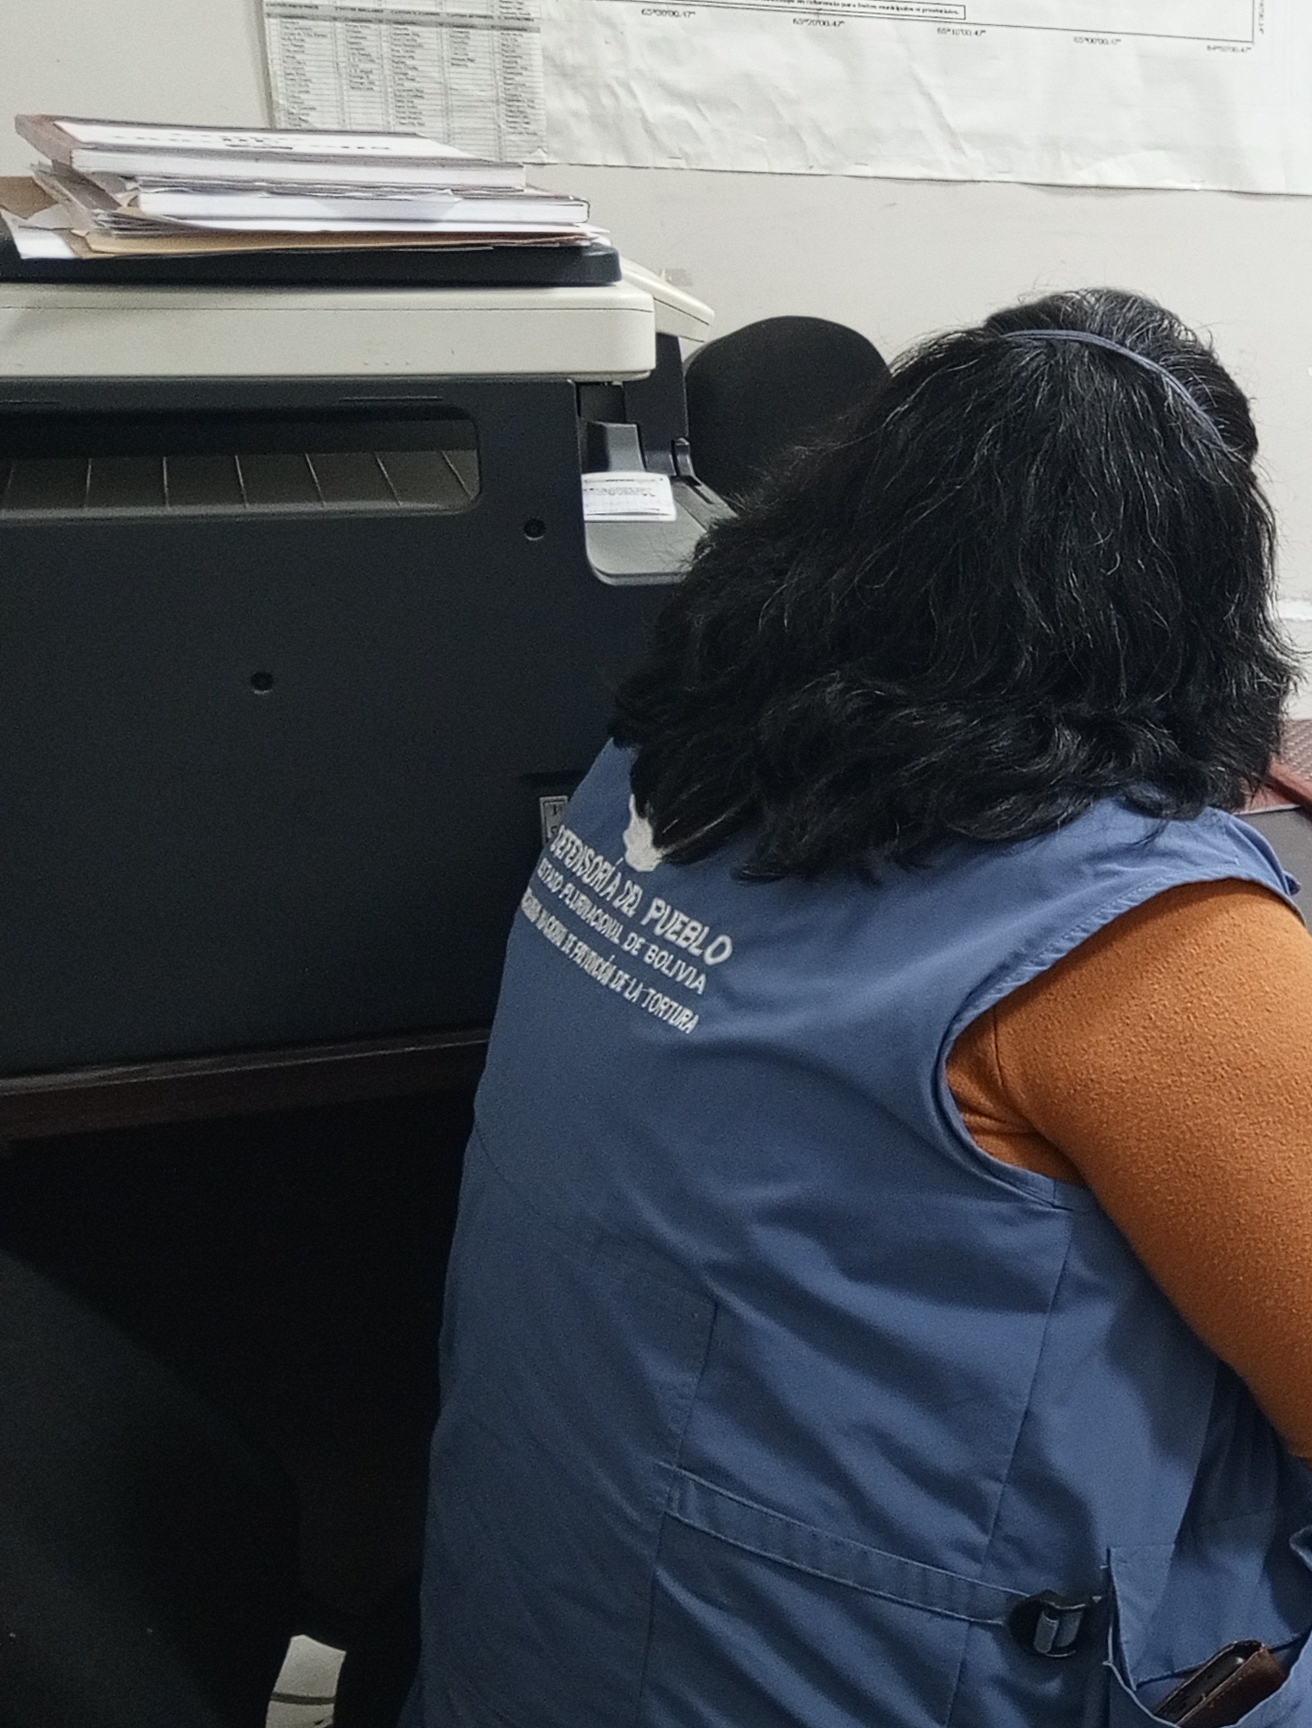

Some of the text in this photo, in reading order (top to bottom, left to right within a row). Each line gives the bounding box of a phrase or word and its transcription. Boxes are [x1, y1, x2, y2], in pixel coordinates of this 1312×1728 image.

[537, 857, 564, 894] ESTADO
[558, 882, 624, 946] PLURINACIONAL
[621, 931, 647, 957] DE
[643, 943, 707, 996] BOLIVIA
[612, 879, 644, 919] DEL
[640, 896, 733, 967] PUEBLO
[608, 968, 632, 993] DE
[622, 977, 645, 1004] LA
[641, 985, 700, 1036] TORTURA
